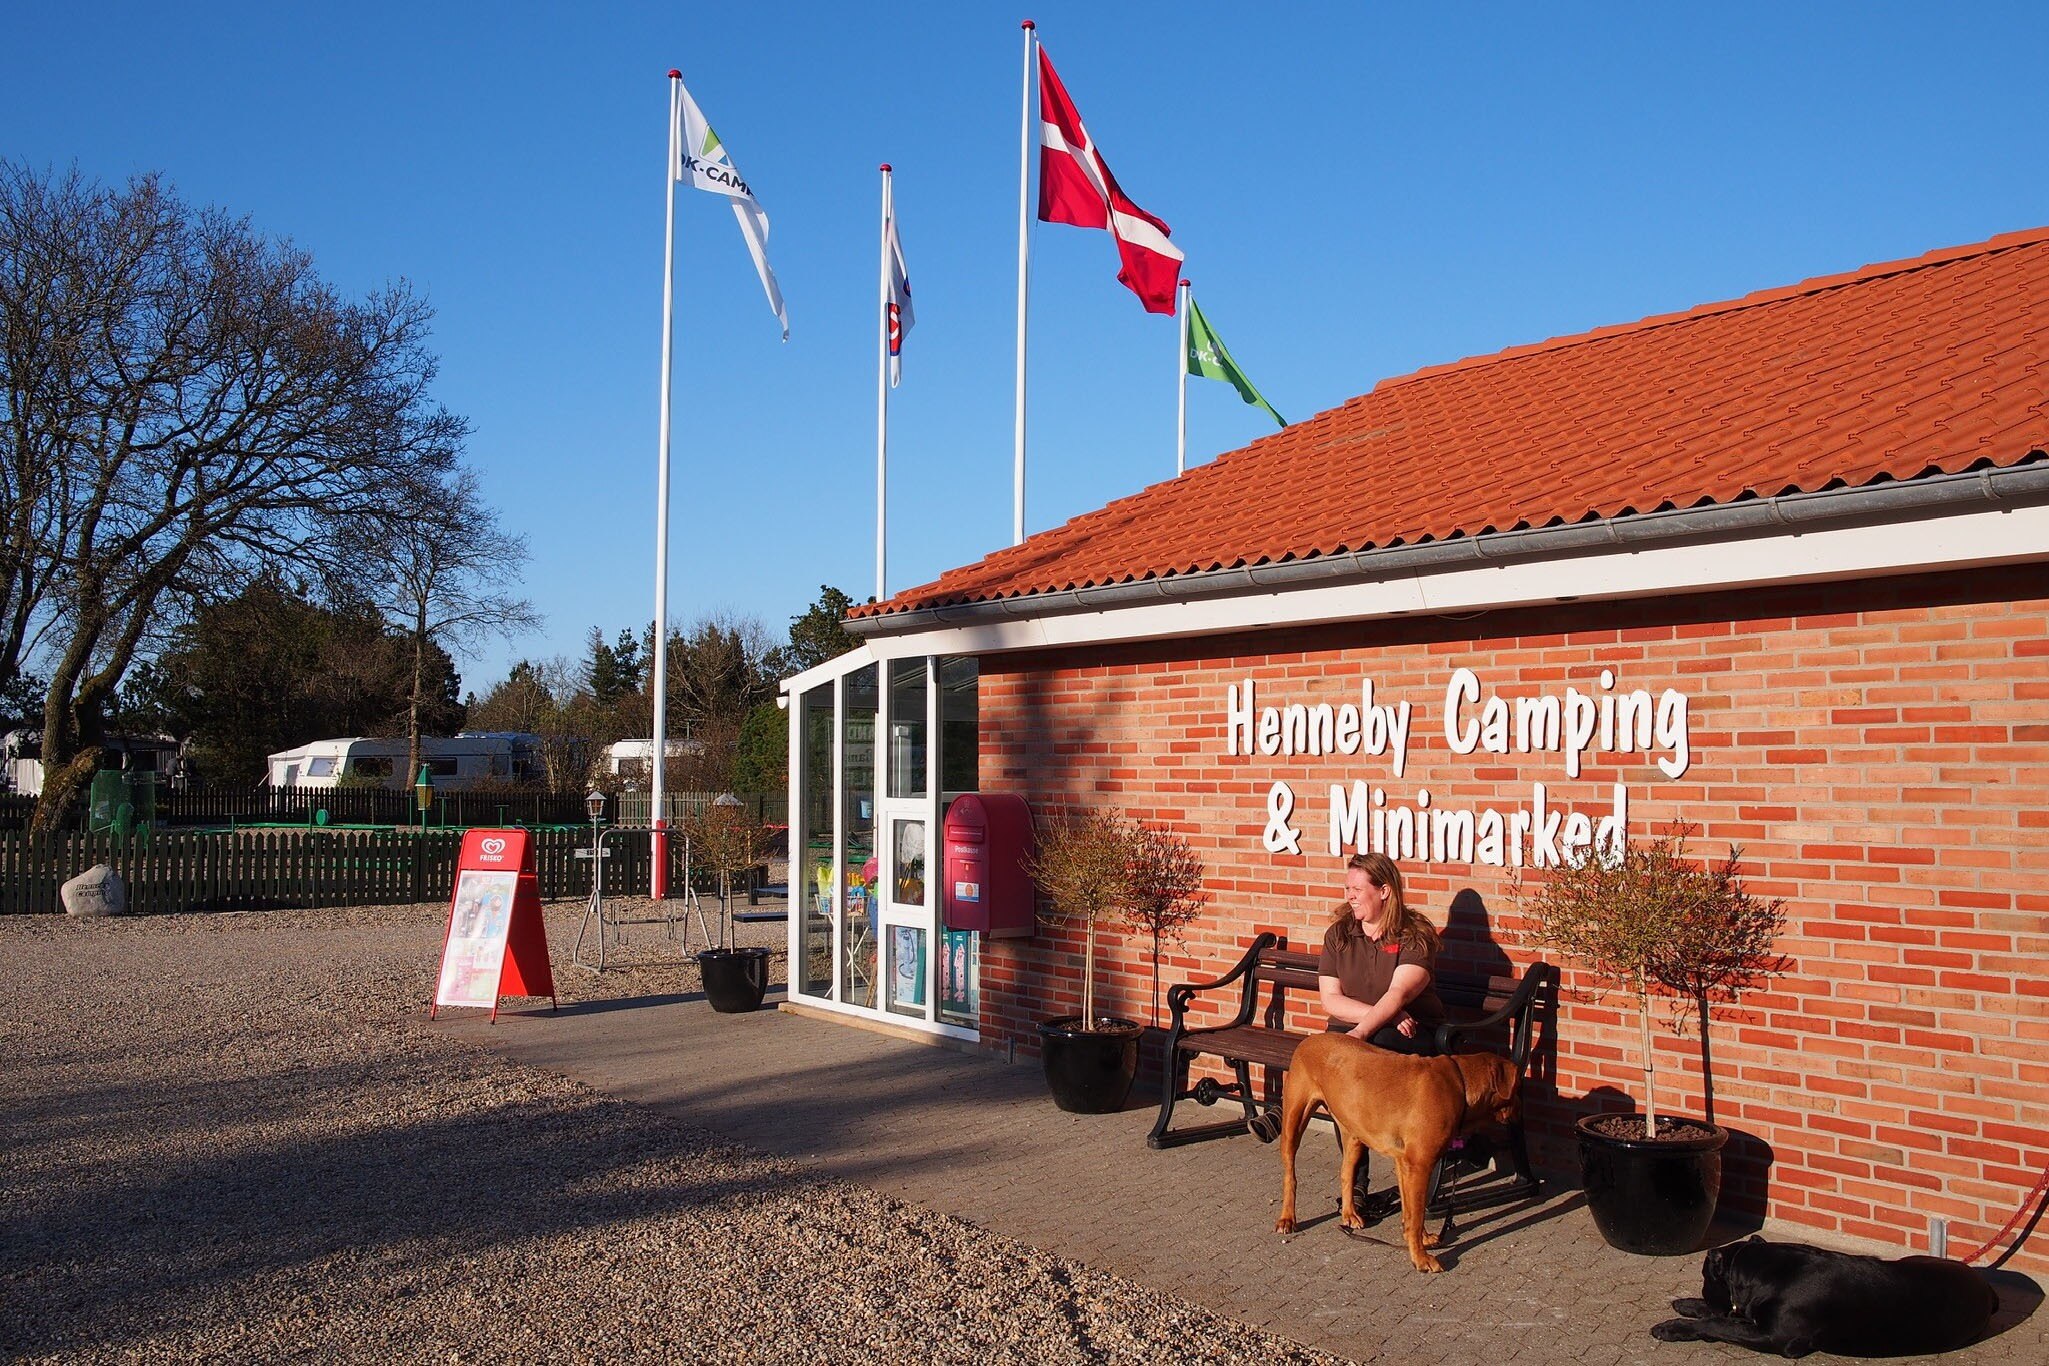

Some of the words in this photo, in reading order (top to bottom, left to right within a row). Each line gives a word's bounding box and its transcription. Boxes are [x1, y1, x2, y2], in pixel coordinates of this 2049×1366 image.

[1226, 677, 1412, 779] Henneby
[1444, 666, 1690, 780] Camping
[479, 855, 503, 863] FRISKO
[1262, 780, 1303, 857] &
[1329, 779, 1629, 873] Minimarked
